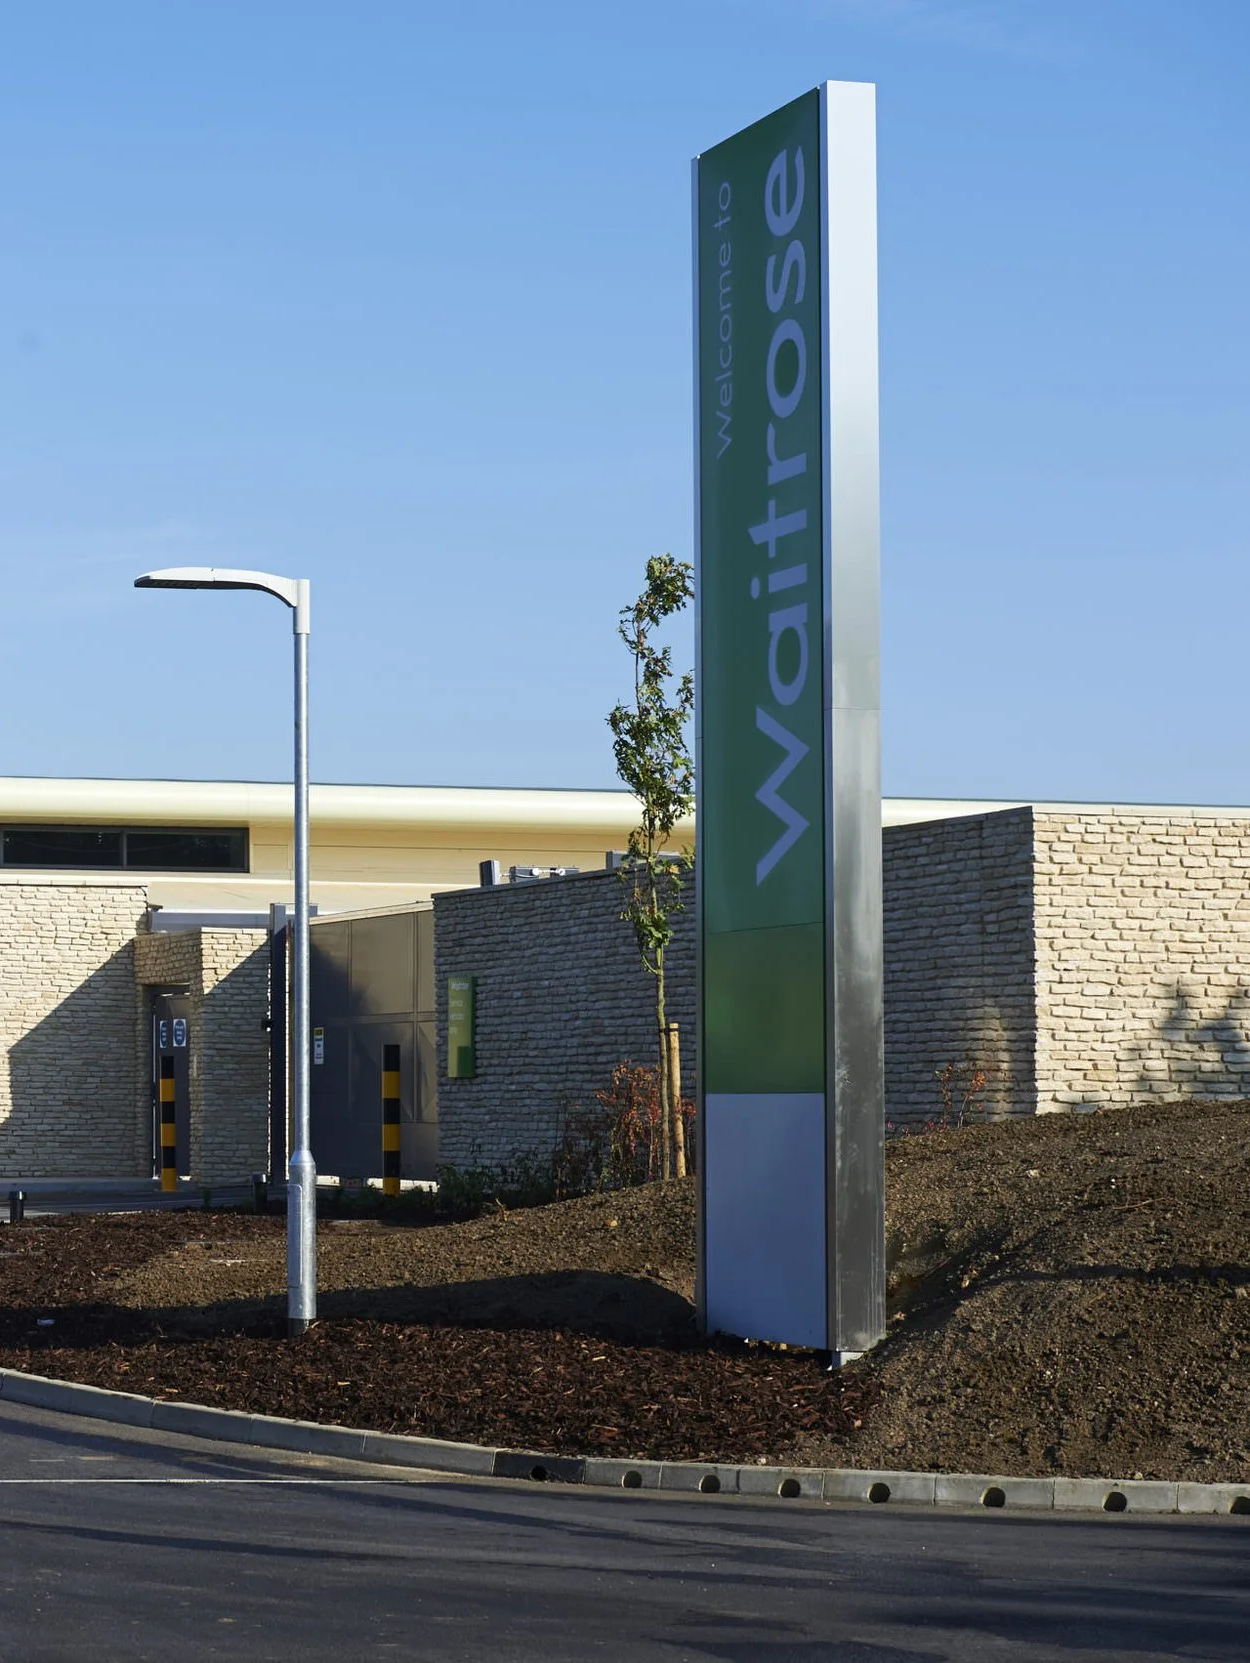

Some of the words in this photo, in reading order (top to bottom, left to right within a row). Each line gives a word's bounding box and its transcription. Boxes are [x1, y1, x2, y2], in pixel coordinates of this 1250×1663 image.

[714, 181, 732, 231] to
[714, 242, 734, 458] Welcome
[748, 146, 810, 886] Waitrose
